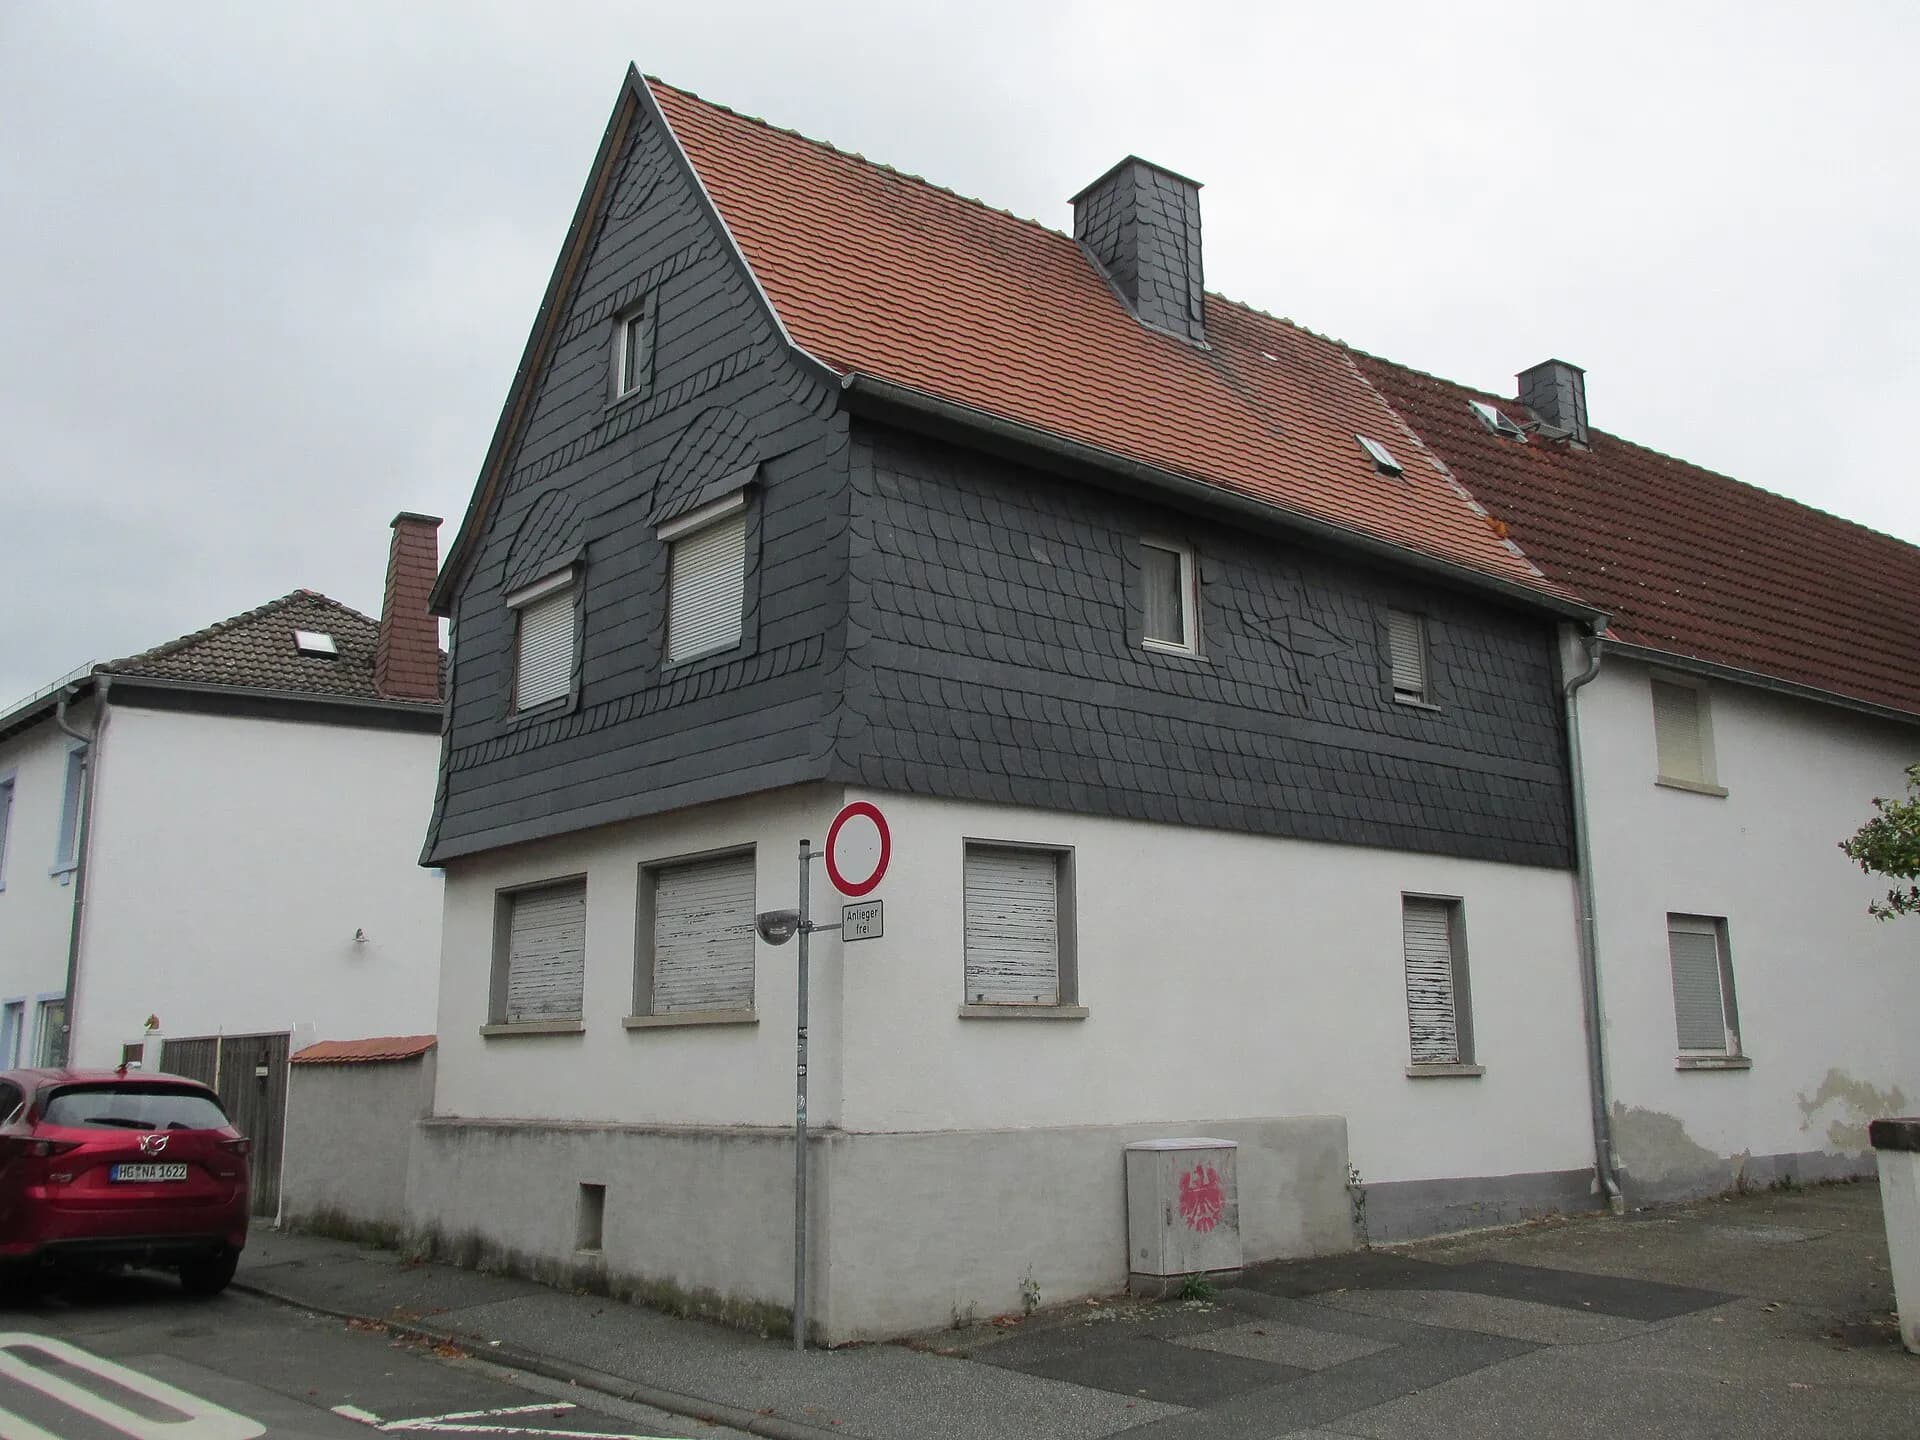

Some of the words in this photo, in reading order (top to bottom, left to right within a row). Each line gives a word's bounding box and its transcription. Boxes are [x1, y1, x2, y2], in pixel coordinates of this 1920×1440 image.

[846, 909, 878, 921] Anlieger
[856, 923, 870, 934] frei
[159, 1165, 186, 1178] 1622
